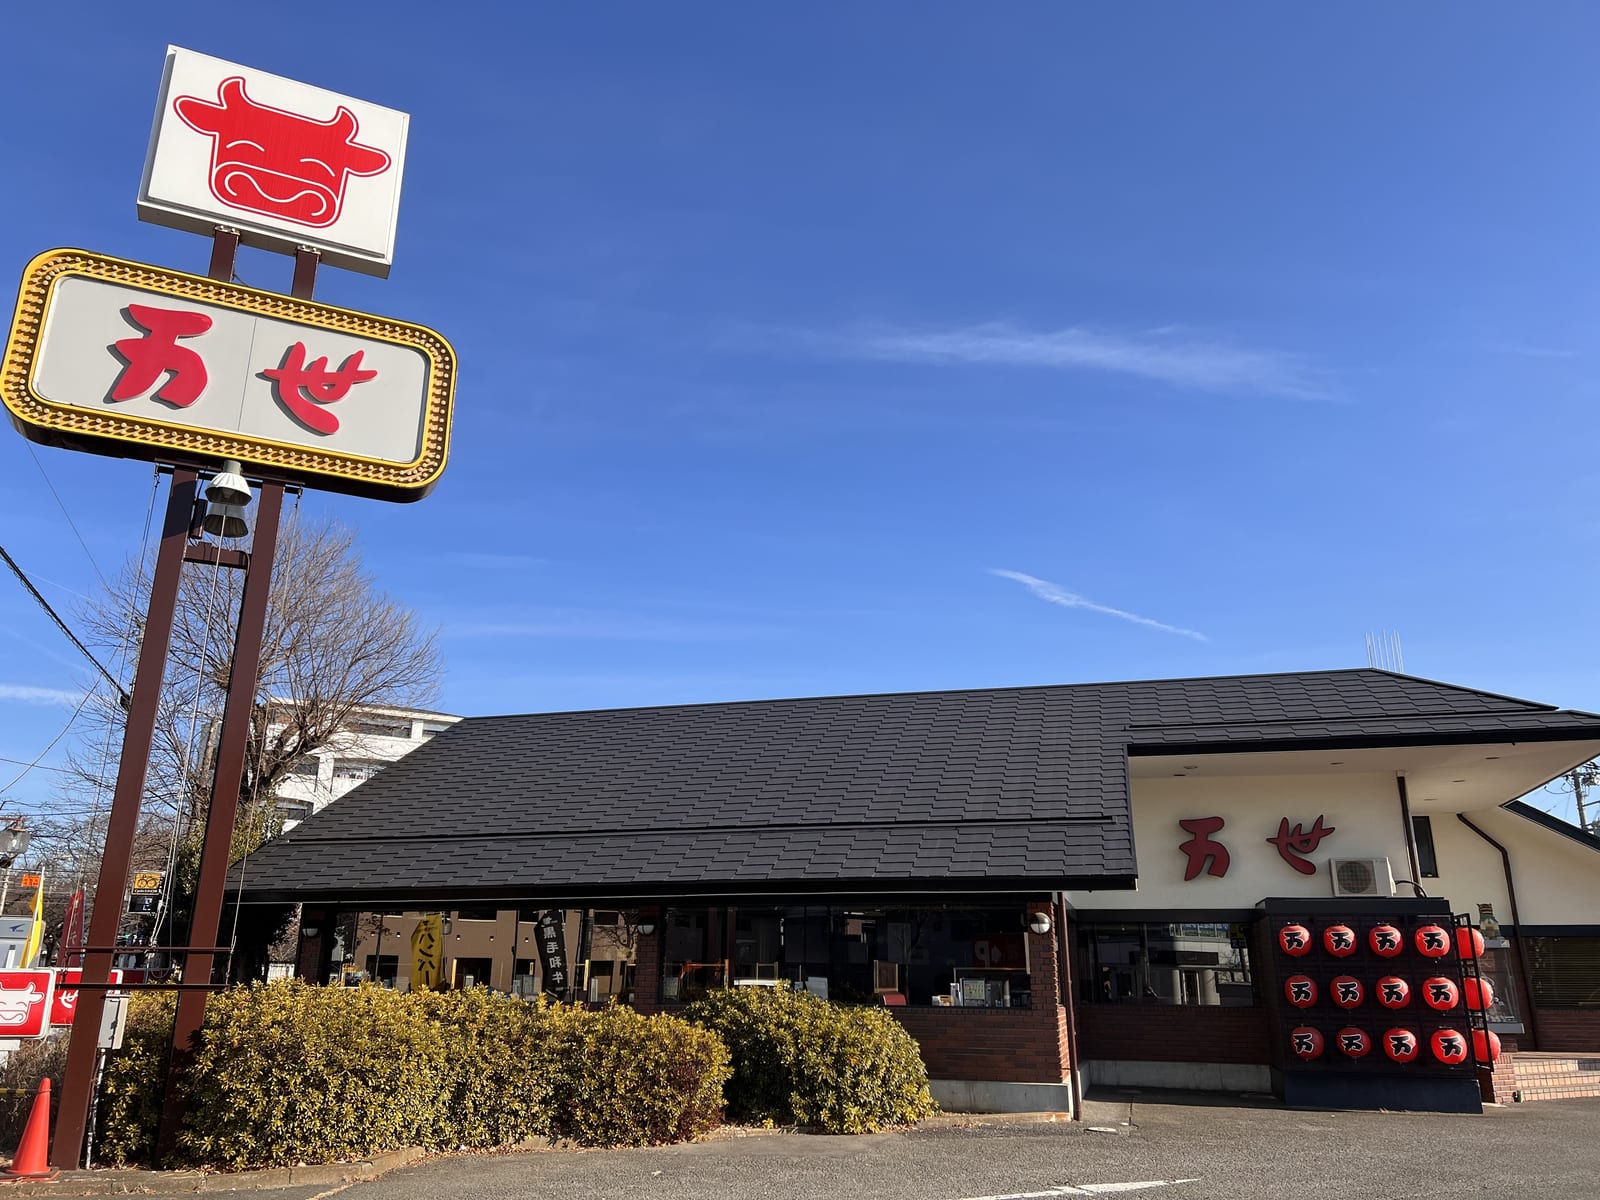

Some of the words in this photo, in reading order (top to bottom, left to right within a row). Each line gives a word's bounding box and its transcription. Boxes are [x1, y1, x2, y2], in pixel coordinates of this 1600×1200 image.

[111, 303, 378, 435] 万世
[1179, 814, 1336, 882] 万世
[1284, 931, 1304, 950] 万
[1330, 931, 1351, 951] 万
[1376, 931, 1397, 951] 万
[1422, 931, 1443, 951] 万
[1291, 982, 1311, 1002] 万
[1337, 982, 1360, 1003] 万
[1381, 983, 1404, 1003] 万
[1429, 983, 1452, 1004] 万
[1293, 1033, 1314, 1054] 万
[1340, 1034, 1363, 1052] 万
[1389, 1035, 1413, 1056] 万
[1440, 1037, 1463, 1059] 万
